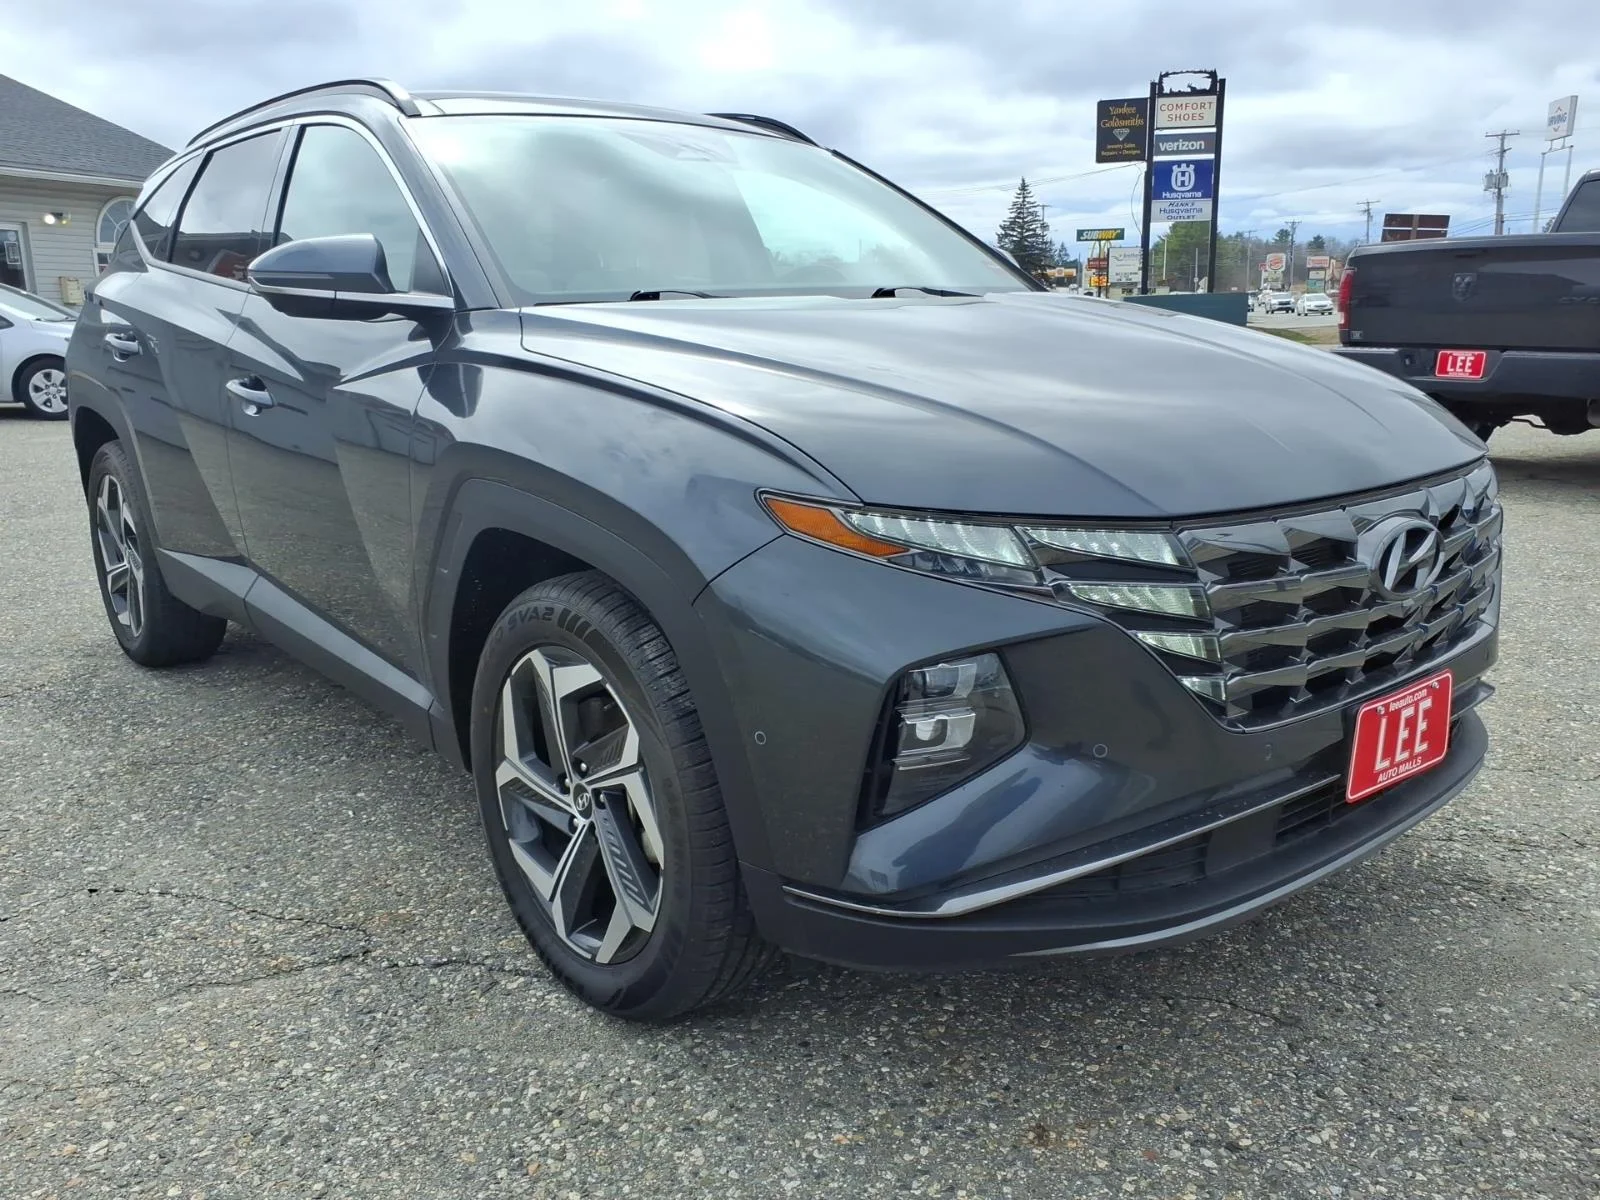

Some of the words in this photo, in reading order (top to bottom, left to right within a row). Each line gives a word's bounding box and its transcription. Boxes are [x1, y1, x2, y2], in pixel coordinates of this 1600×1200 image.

[1109, 102, 1137, 115] Yankee
[1160, 101, 1213, 112] COMFORT
[1101, 114, 1144, 128] Goldsmiths
[1167, 112, 1205, 122] SHOES
[1159, 139, 1205, 151] verizon
[1162, 191, 1202, 199] Husqvarna
[1080, 230, 1120, 240] SUBWAY
[1446, 355, 1475, 372] LEE
[1389, 689, 1427, 712] leeauto.com
[1374, 697, 1433, 773] LEE
[1377, 766, 1398, 783] AUTO
[1398, 757, 1422, 774] MALLS
